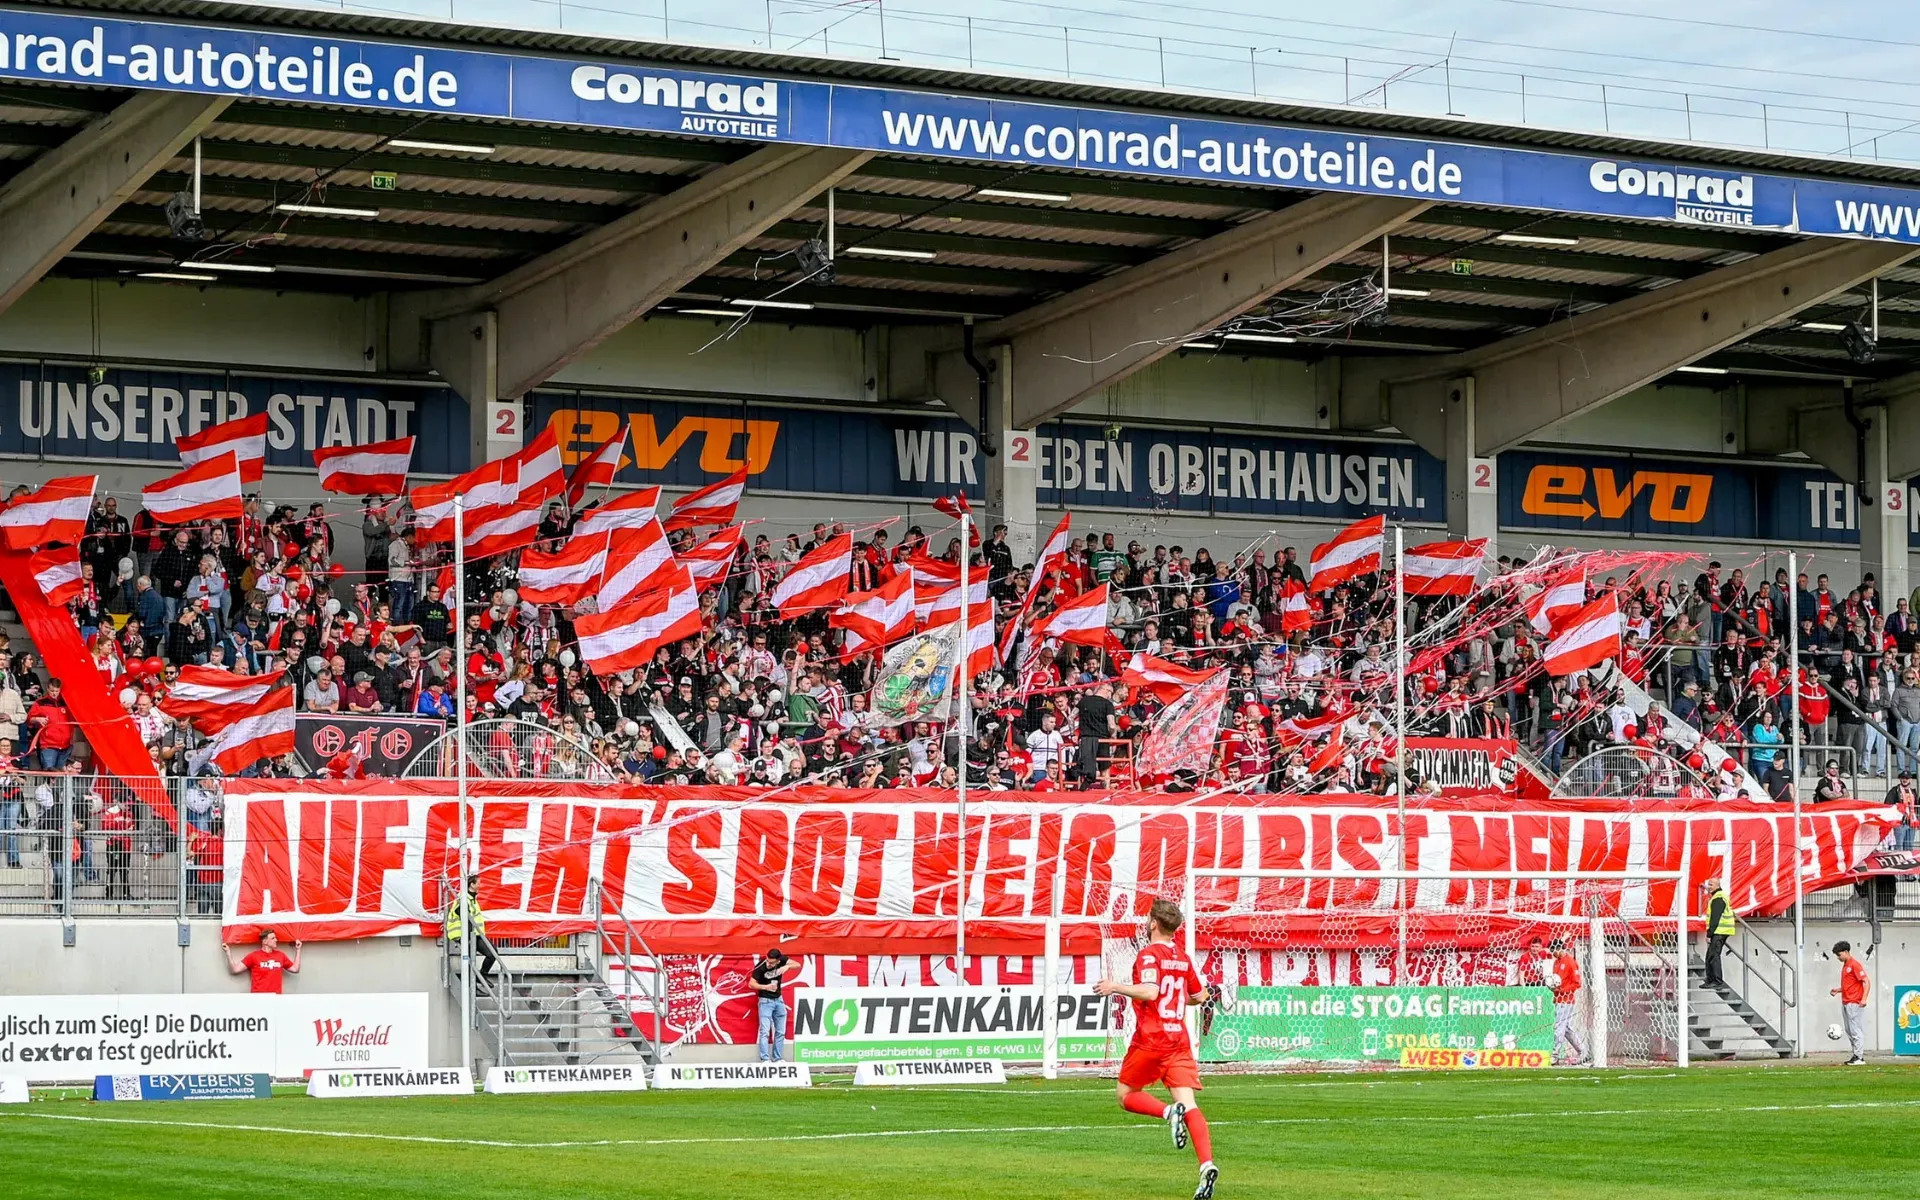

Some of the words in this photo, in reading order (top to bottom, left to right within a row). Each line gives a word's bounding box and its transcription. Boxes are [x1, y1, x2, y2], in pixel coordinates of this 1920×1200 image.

[571, 65, 777, 117] Conrad
[680, 116, 777, 137] AUTOTEILE
[882, 110, 1462, 196] www.conrad-autoteile.de
[1589, 161, 1753, 207] Conrad
[1678, 206, 1753, 226] AUTOTEILE
[267, 393, 415, 451] STADT
[495, 409, 515, 435] 2
[547, 409, 780, 475] evo
[1012, 437, 1029, 461] 2
[895, 429, 977, 485] WIR
[1035, 436, 1133, 493] EBEN
[1148, 443, 1425, 509] OBERHAUSEN.
[1474, 463, 1492, 488] 2
[1521, 464, 1714, 523] evo
[1805, 481, 1860, 530] TEI
[1887, 488, 1903, 511] 3
[237, 799, 409, 916] AUF
[733, 807, 899, 916] ROT
[1134, 811, 1245, 914] DU
[1255, 813, 1430, 912] BIST
[1446, 814, 1631, 917] MEIN
[1158, 975, 1185, 1020] 21
[1287, 994, 1308, 1016] in
[1311, 994, 1346, 1016] die
[1351, 994, 1444, 1019] STOAG
[1449, 995, 1543, 1016] Fanzone!
[55, 1019, 96, 1035] zum
[101, 1014, 149, 1039] Sieg!
[156, 1014, 185, 1033] Die
[190, 1014, 269, 1033] Daumen
[312, 1018, 393, 1046] Westfield
[1905, 1032, 1920, 1044] RU
[0, 1042, 14, 1062] d
[20, 1043, 93, 1062] extra
[98, 1040, 135, 1060] fest
[140, 1038, 232, 1065] gedrückt.
[801, 1046, 933, 1059] Entsorgungsfachbetrieb
[935, 1047, 963, 1058] gem.
[965, 1045, 974, 1057] §
[993, 1044, 1025, 1054] KrWG
[1059, 1043, 1067, 1055] §
[1069, 1043, 1083, 1053] 57
[1248, 1033, 1312, 1050] stoag.de
[1385, 1034, 1441, 1049] STOAG
[1448, 1034, 1476, 1050] App
[334, 1049, 371, 1062] CENTRO
[1407, 1050, 1463, 1067] WEST
[1480, 1051, 1544, 1067] LOTTO
